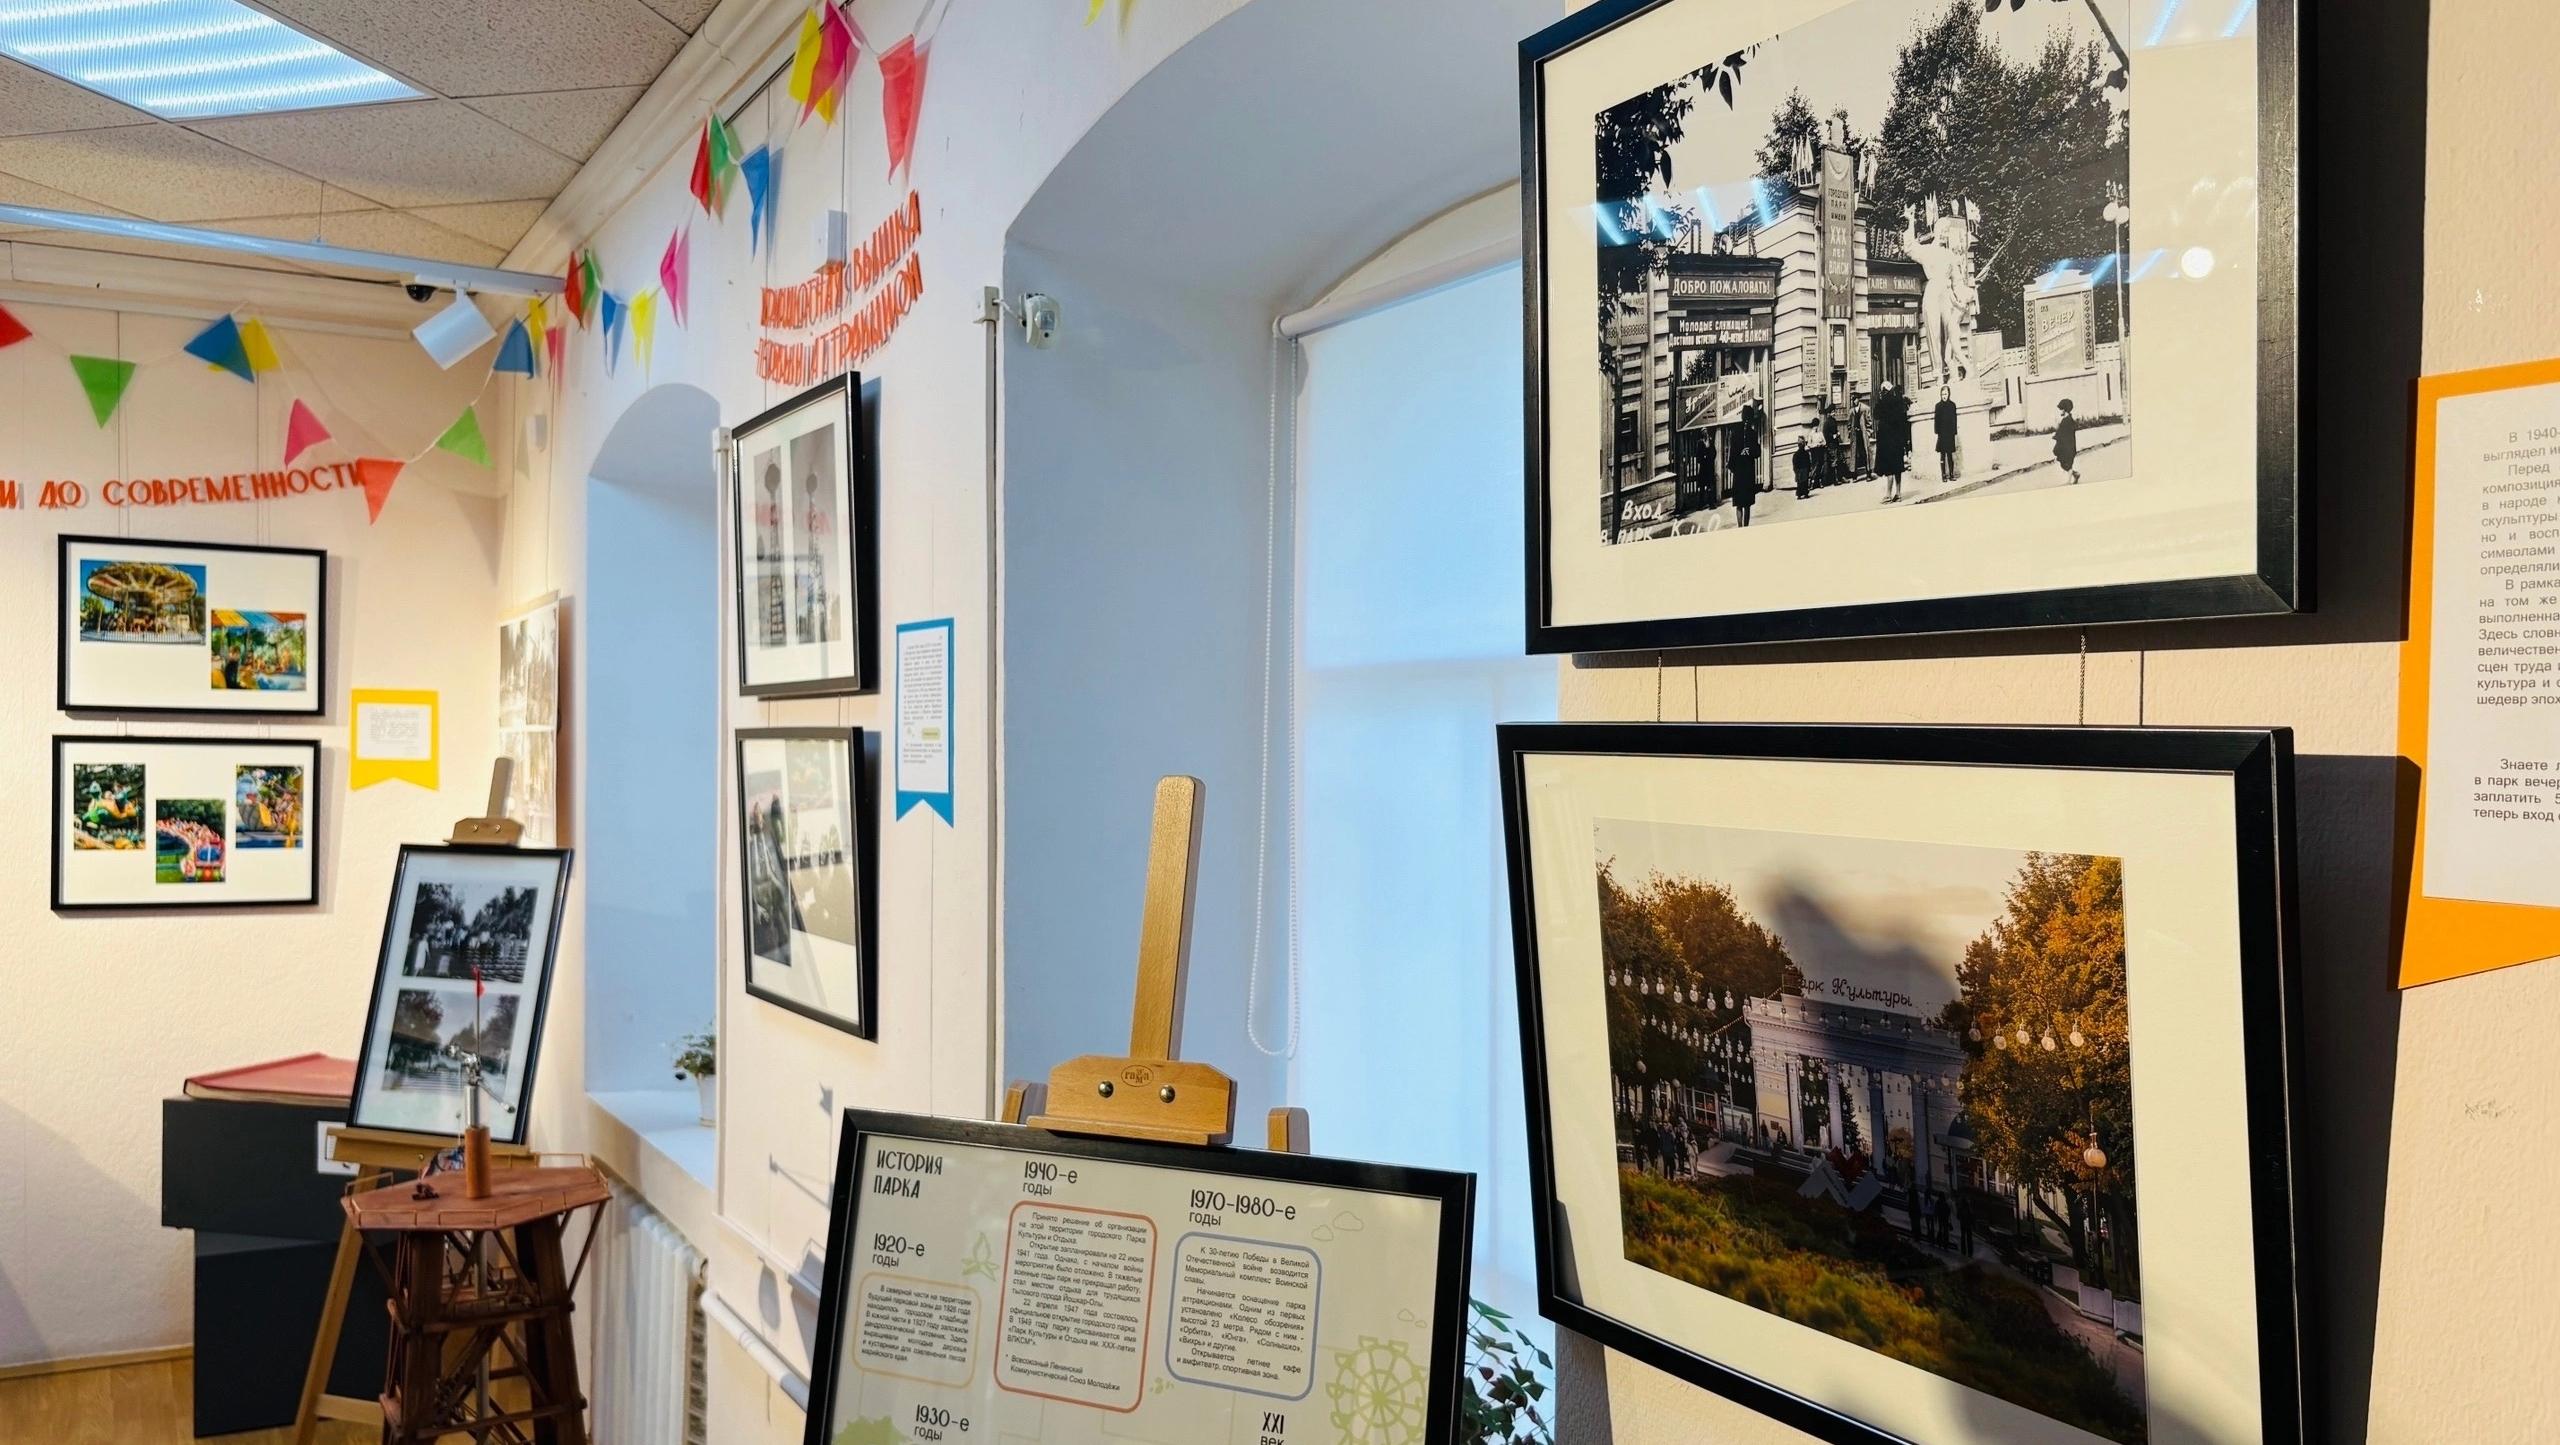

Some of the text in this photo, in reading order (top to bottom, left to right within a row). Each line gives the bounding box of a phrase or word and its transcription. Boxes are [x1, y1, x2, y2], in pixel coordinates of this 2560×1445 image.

[853, 189, 922, 293] ВЫШКА
[1672, 278, 1770, 296] ДОБРО ПОЖАЛОВАТЬ!
[2509, 431, 2518, 443] В
[2483, 446, 2560, 461] выглядел и
[2508, 463, 2550, 476] Перед
[39, 480, 81, 510] ДО
[103, 463, 368, 507] СОВРЕМЕННОСТИ
[2482, 479, 2560, 494] композиция
[2482, 496, 2547, 510] в народе
[2481, 513, 2558, 528] скульптуры
[2481, 528, 2559, 543] но и восп
[2480, 546, 2555, 559] символами
[2480, 562, 2560, 576] определяли
[2505, 579, 2560, 592] В рамка
[2479, 595, 2557, 608] на том же
[2479, 612, 2560, 624] выполненна
[2478, 628, 2518, 641] Здесь
[2477, 662, 2552, 674] сцен труда
[2477, 679, 2550, 691] культура и
[2477, 695, 2560, 707] шедевр эпох
[2500, 758, 2548, 771] Знаете
[2474, 777, 2482, 785] в
[2488, 777, 2519, 788] парк
[2473, 792, 2542, 804] заплатить
[2473, 809, 2554, 823] теперь вход
[1800, 978, 1912, 1008] арк Культуры
[876, 1149, 943, 1176] ИСТОРИЯ
[1024, 1160, 1078, 1184] 1940-е
[873, 1175, 921, 1199] ПАРКА
[1022, 1180, 1053, 1196] годы
[1190, 1189, 1296, 1221] 1970-1980-е
[1189, 1211, 1221, 1227] годы
[874, 1233, 925, 1258] 1920-е
[872, 1251, 899, 1268] годы
[1117, 1252, 1126, 1261] 22
[1210, 1318, 1220, 1328] 23
[915, 1403, 970, 1433] 1930-е
[1262, 1411, 1284, 1434] XXI
[914, 1424, 943, 1441] годы
